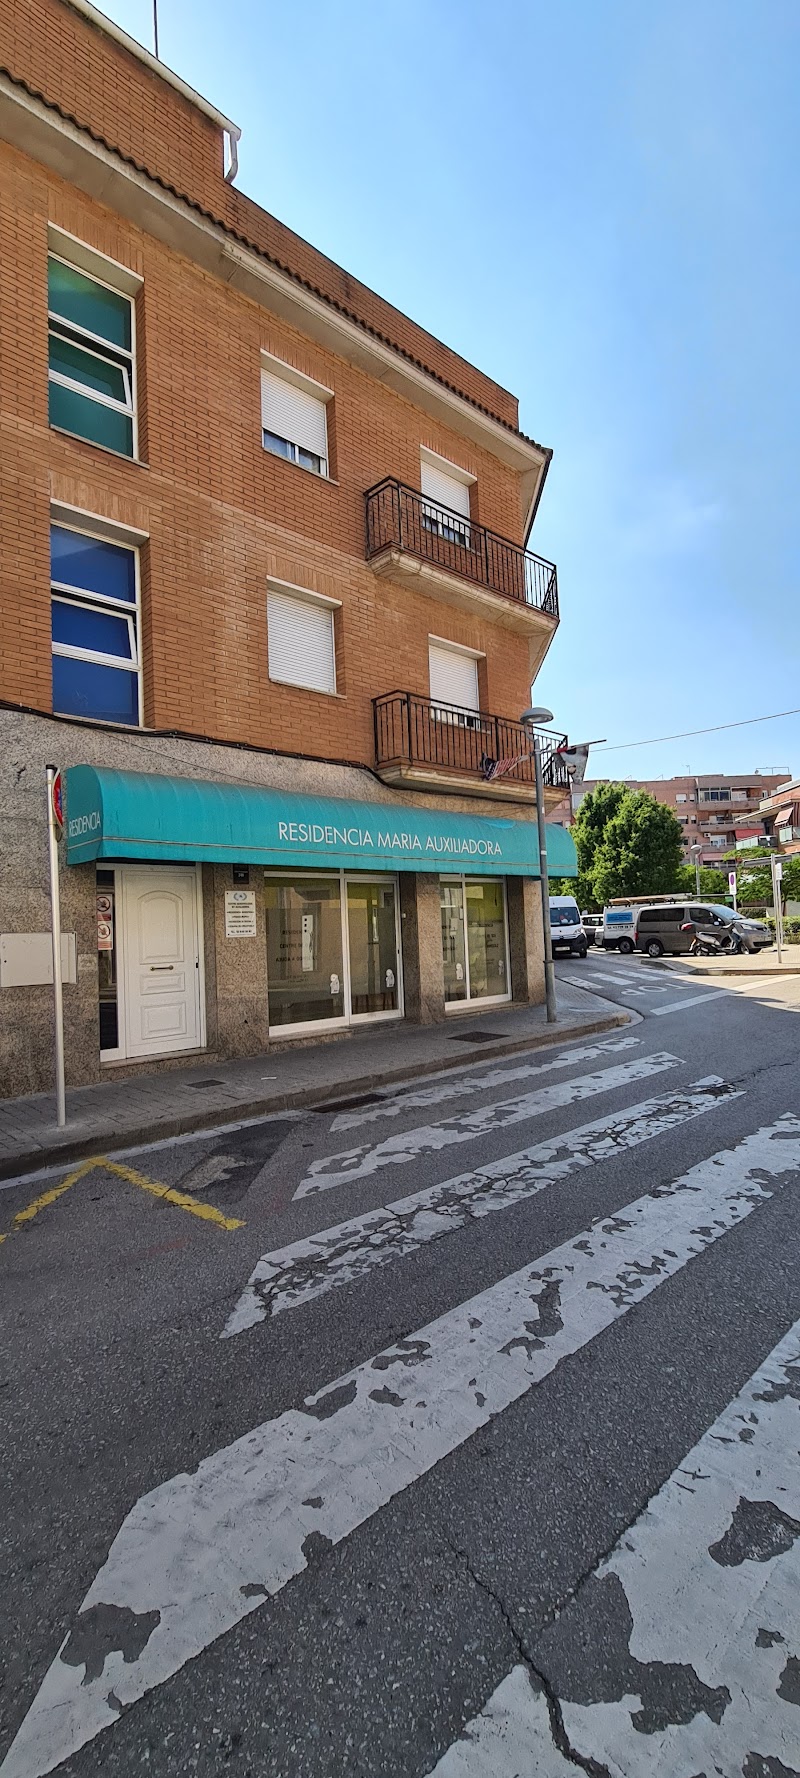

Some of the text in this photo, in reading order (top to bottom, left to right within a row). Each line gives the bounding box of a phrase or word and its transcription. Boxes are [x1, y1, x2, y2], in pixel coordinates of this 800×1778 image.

[69, 811, 101, 837] RESIDENCIA
[278, 822, 502, 855] RESIDENCIA MARIA AUXILIADORA
